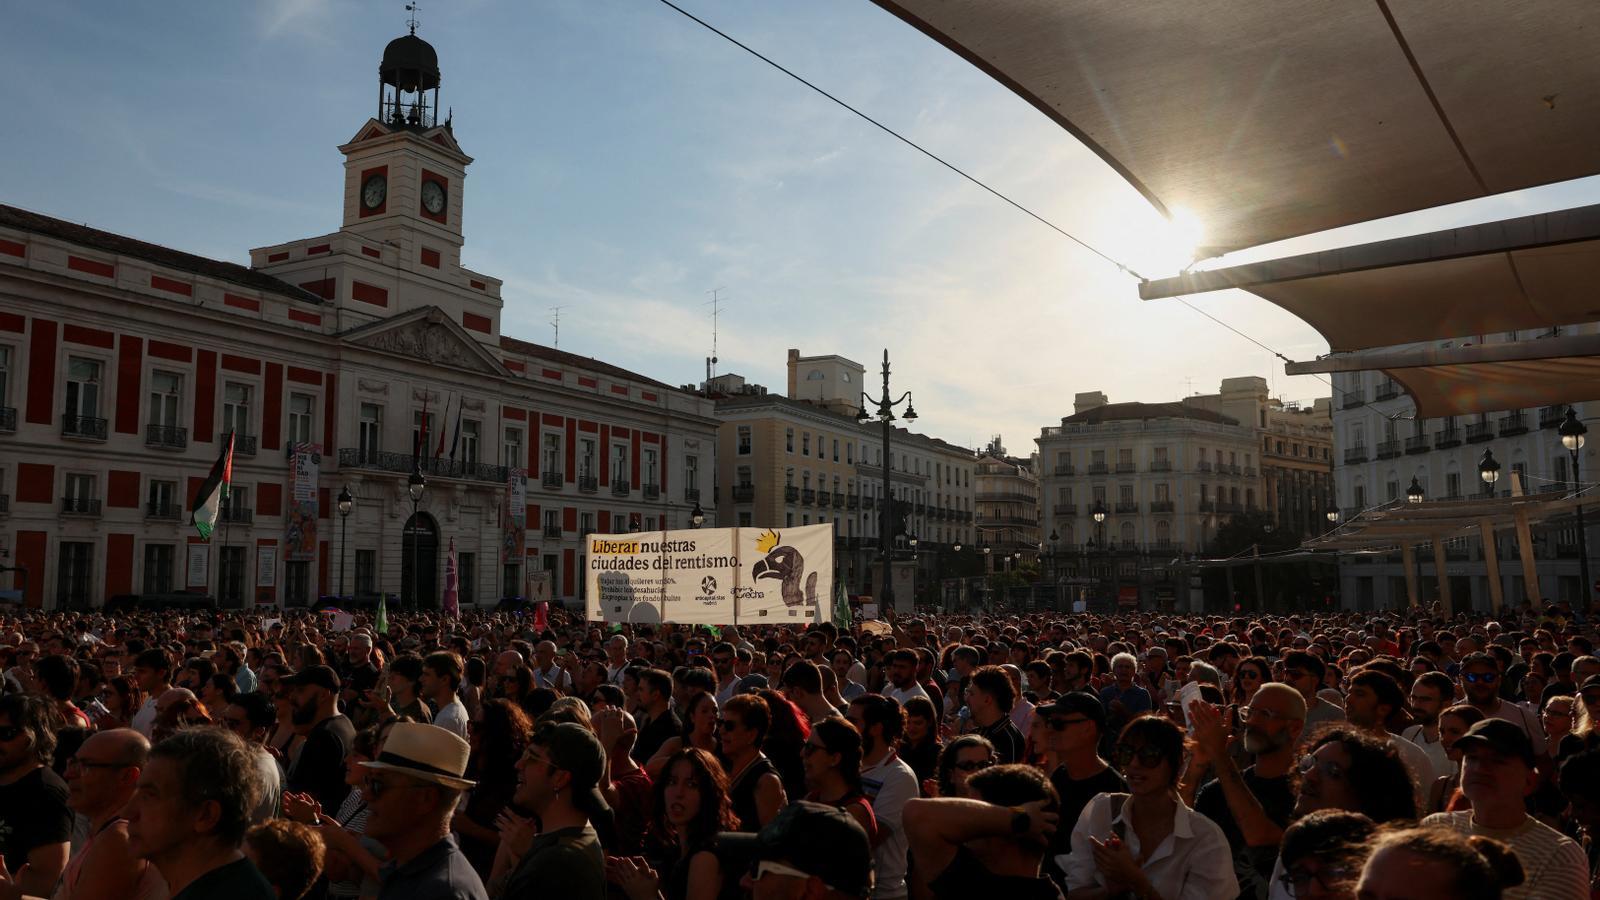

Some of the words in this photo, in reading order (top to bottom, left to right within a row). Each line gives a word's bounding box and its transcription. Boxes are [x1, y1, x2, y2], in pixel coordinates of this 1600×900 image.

[592, 540, 638, 554] Liberar
[640, 540, 696, 553] nuestras
[591, 556, 649, 571] ciudades
[652, 555, 673, 571] del
[675, 553, 743, 570] rentismo.
